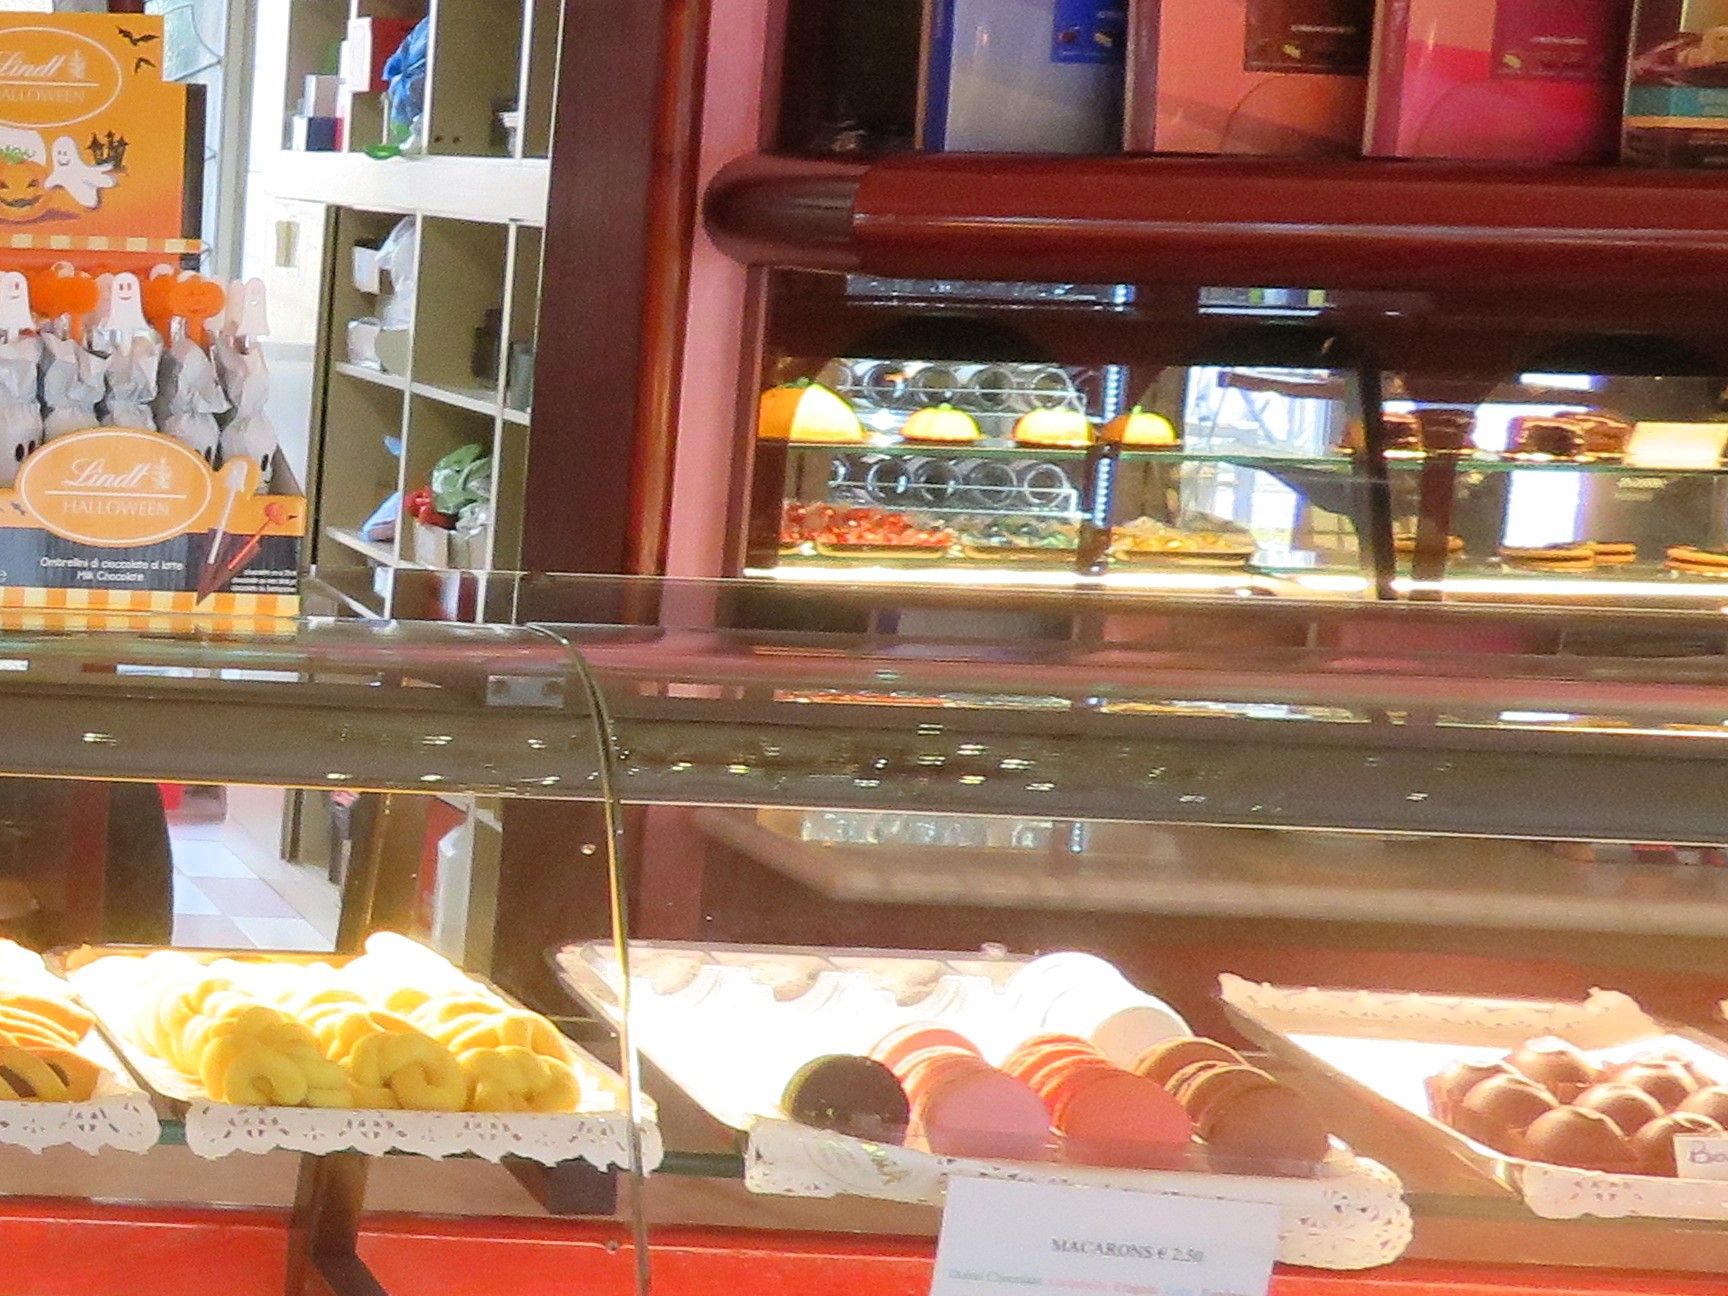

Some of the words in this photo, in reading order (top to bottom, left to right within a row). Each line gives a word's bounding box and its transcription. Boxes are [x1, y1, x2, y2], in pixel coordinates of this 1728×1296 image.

[60, 457, 152, 489] Lindt
[62, 499, 170, 516] HALLOWEEN
[1050, 1237, 1154, 1259] MACARONS
